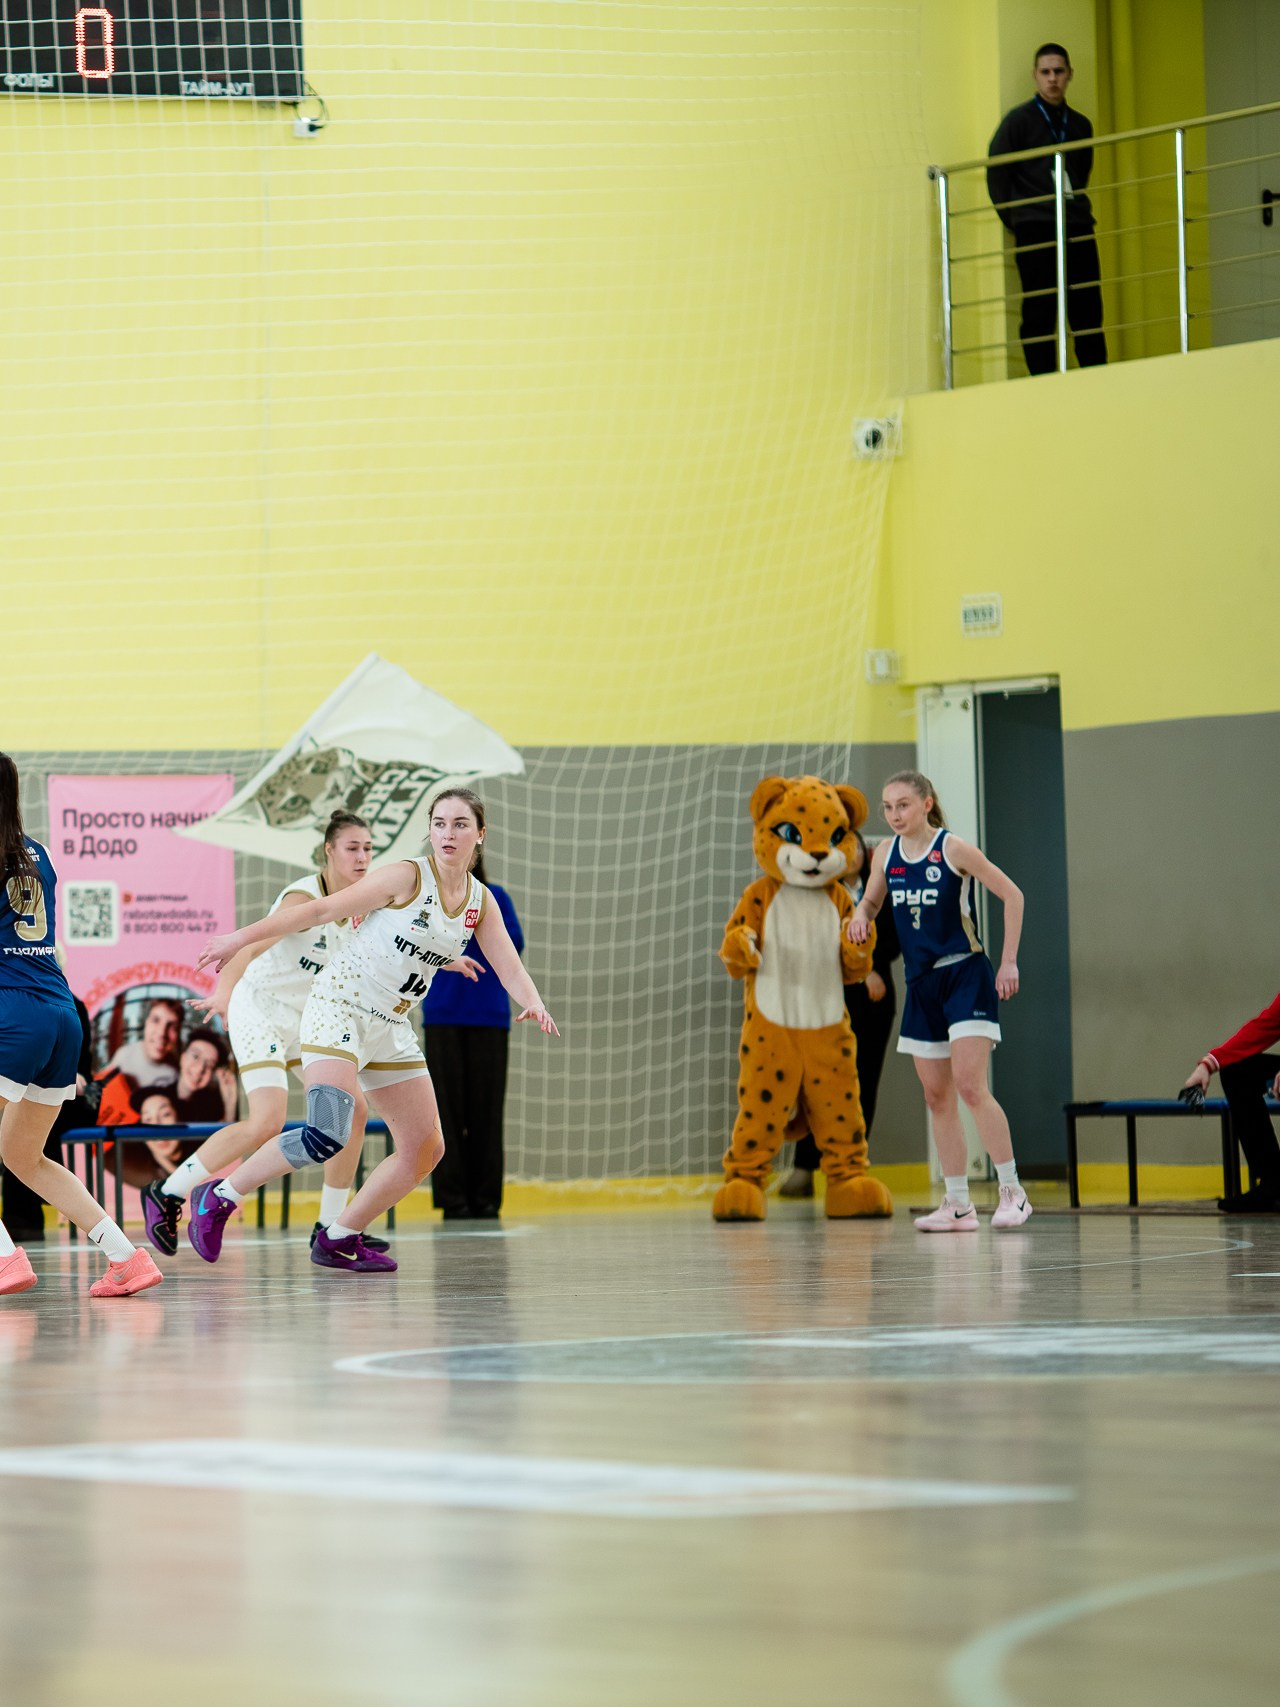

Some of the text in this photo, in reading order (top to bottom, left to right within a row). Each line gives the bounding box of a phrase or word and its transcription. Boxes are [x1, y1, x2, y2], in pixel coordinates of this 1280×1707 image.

[75, 8, 114, 78] 0
[62, 809, 216, 832] Просто начн
[63, 836, 138, 858] в Додо
[6, 875, 48, 941] 9
[891, 888, 939, 907] РУС
[910, 906, 921, 930] 3
[398, 972, 427, 997] 14
